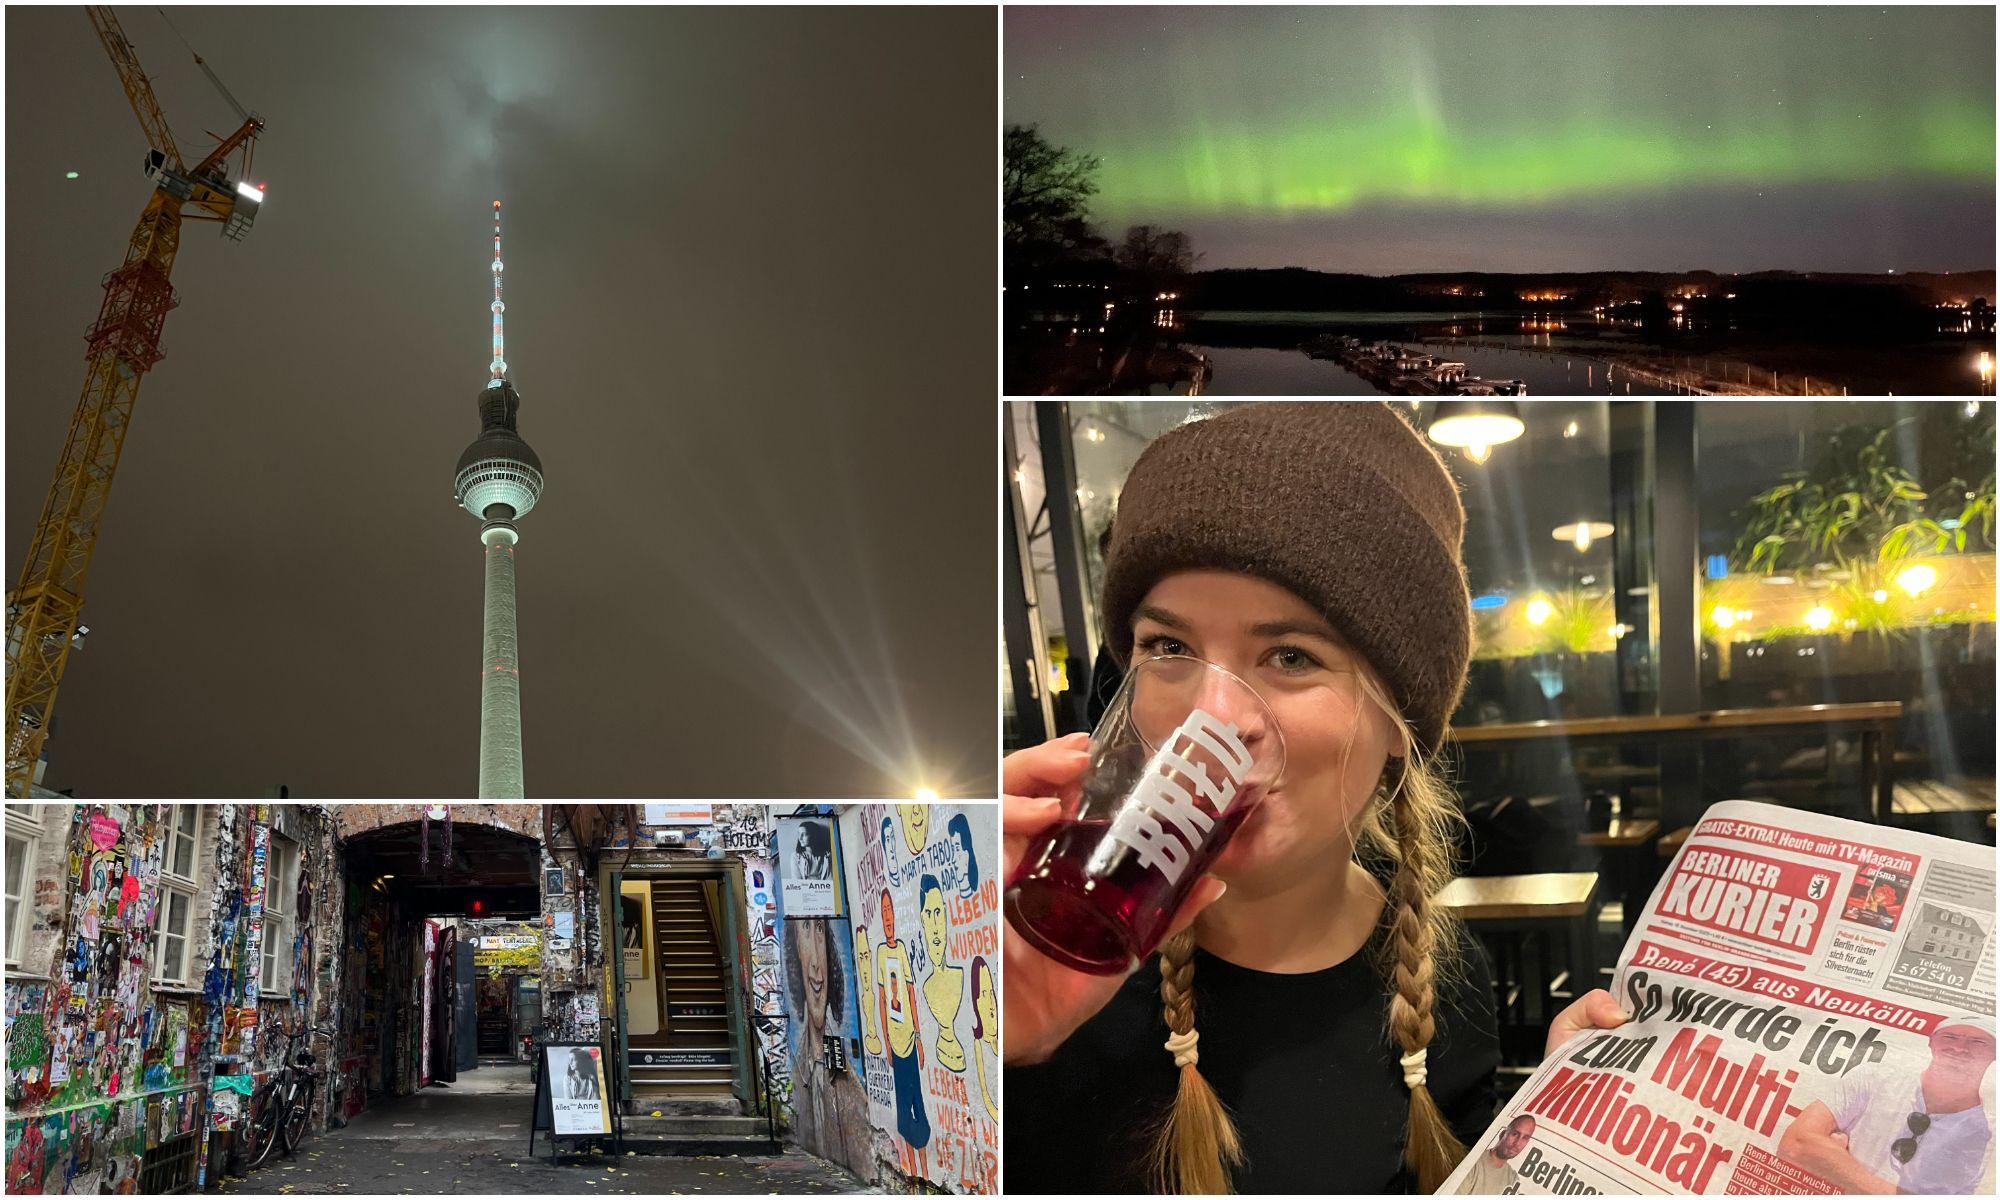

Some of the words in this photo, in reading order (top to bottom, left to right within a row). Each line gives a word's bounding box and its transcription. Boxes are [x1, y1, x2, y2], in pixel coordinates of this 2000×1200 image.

[1699, 819, 1779, 843] GRATIS-EXTRA!
[1778, 833, 1814, 852] Heute
[1815, 840, 1838, 856] mit
[1839, 843, 1912, 872] TV-Magazin
[901, 854, 927, 884] MARTA
[1680, 851, 1781, 888] BERLINER
[1867, 866, 1896, 882] prisma
[809, 882, 831, 890] Anne
[948, 879, 998, 927] LEBEND
[1662, 873, 1818, 948] KURIER
[949, 923, 998, 960] WURDEN
[1833, 937, 1853, 951] Berlin
[1854, 944, 1876, 956] rüstet
[1825, 959, 1874, 979] Silvesternacht
[1829, 950, 1844, 960] sich
[1845, 952, 1857, 964] für
[1856, 956, 1867, 965] die
[1919, 959, 1952, 973] Telefon
[1640, 946, 1696, 974] René
[1699, 960, 1752, 988] (45)
[1753, 975, 1801, 998] aus
[1803, 987, 1928, 1031] Neukölln
[1899, 962, 1909, 973] 5
[1910, 965, 1927, 976] 67
[1928, 970, 1947, 982] 54
[1947, 974, 1965, 986] 02
[1627, 970, 1663, 1024] So
[1664, 986, 1802, 1052] wurde
[1799, 1017, 1887, 1079] ich
[927, 1065, 969, 1106] LEBEND
[1569, 1034, 1658, 1074] zum
[1650, 1027, 1803, 1138] Multi-
[577, 1102, 599, 1110] Anne
[1524, 1066, 1733, 1195] Millionär
[1734, 1169, 1758, 1189] heute
[1739, 1156, 1764, 1177] Berlin
[1766, 1171, 1781, 1183] auf
[1745, 1143, 1767, 1161] René
[1767, 1156, 1802, 1179] Meinert
[1803, 1173, 1831, 1194] wuchs
[1728, 1182, 1737, 1193] in
